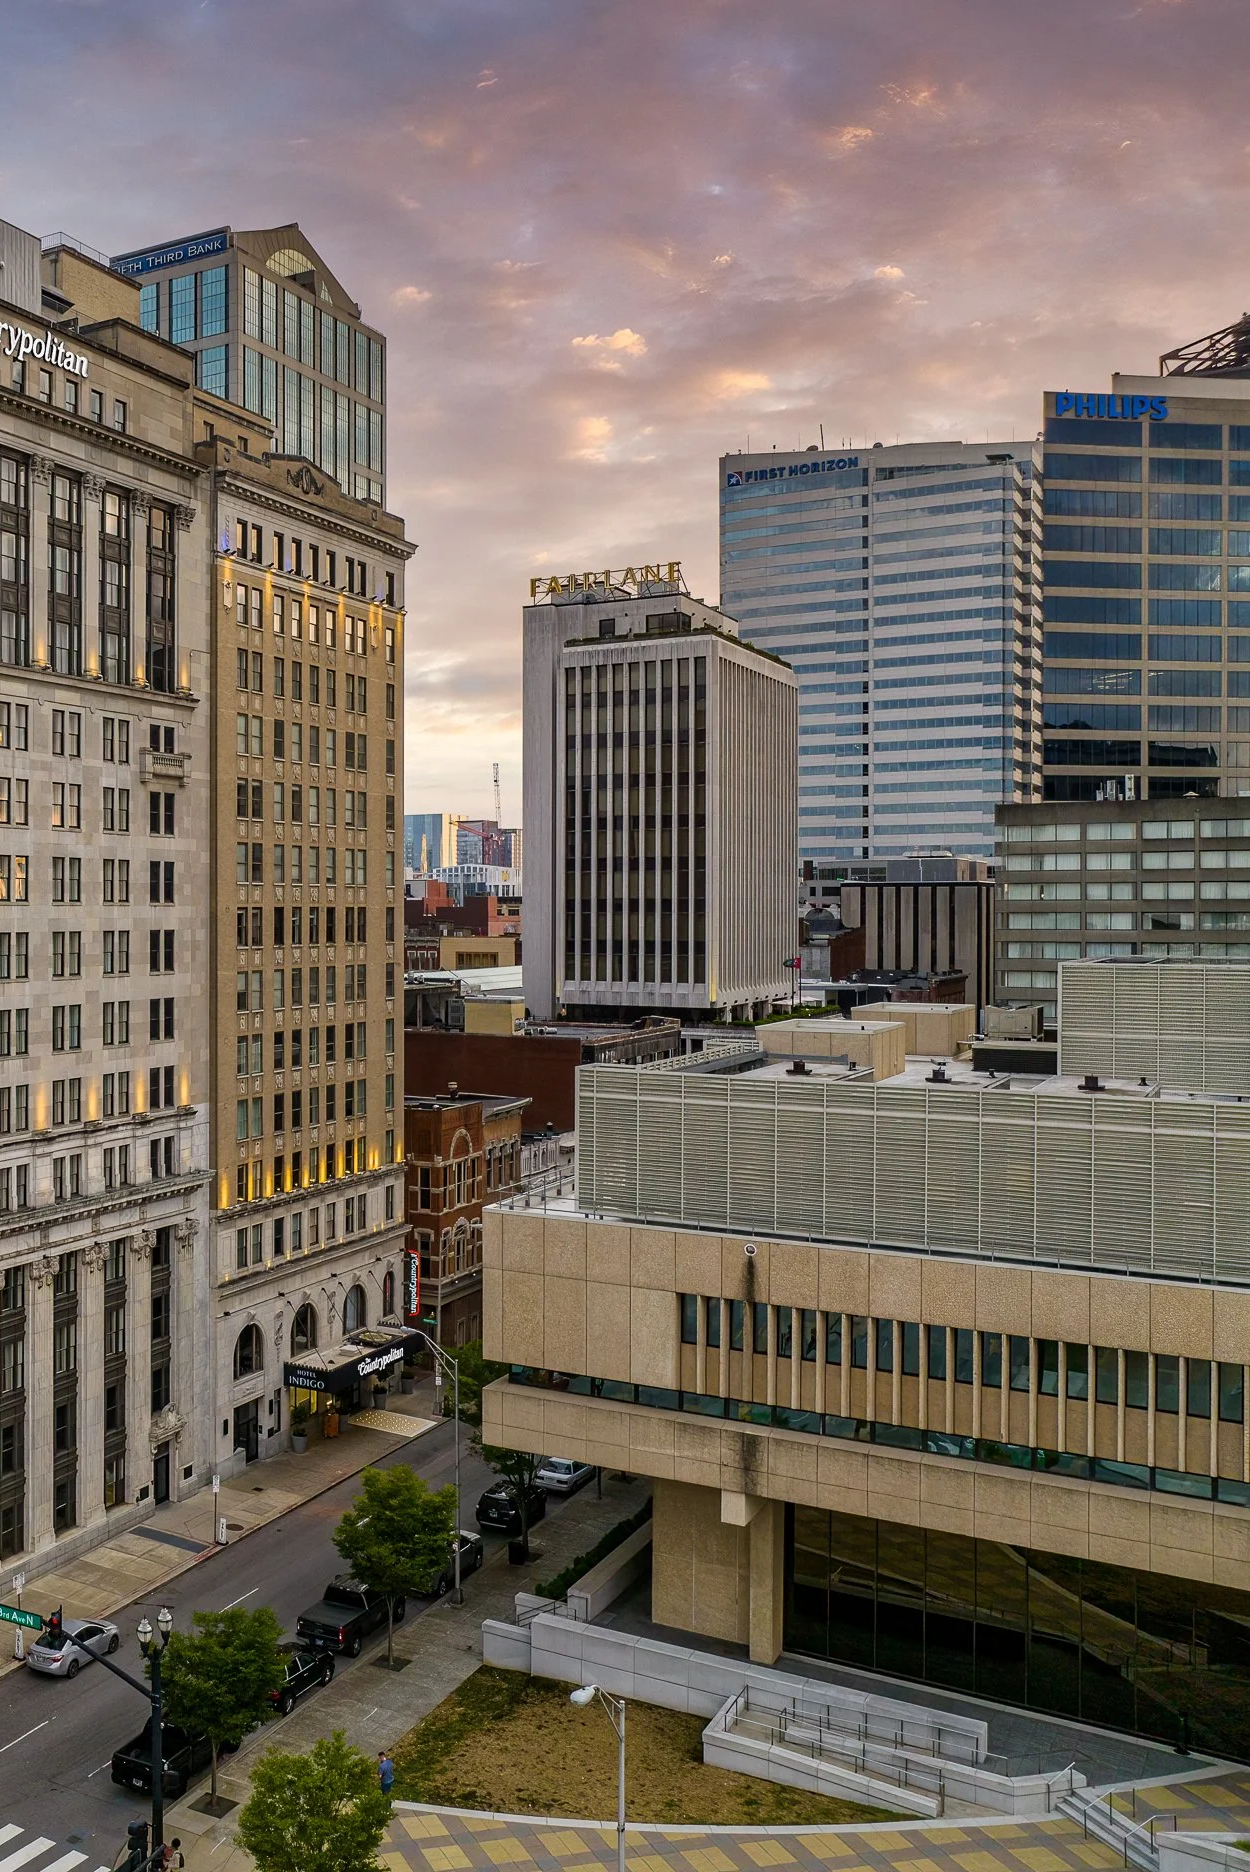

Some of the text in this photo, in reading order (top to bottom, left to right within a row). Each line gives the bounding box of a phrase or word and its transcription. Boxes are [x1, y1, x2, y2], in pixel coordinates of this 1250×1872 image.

[146, 250, 184, 268] THIRD
[188, 240, 222, 257] BANK
[1055, 392, 1169, 421] PHILIPS
[744, 456, 859, 483] FIRST HORIZON
[530, 561, 682, 597] FAIRLANE
[409, 1257, 419, 1314] Countrypolitan
[297, 1369, 317, 1379] HOTEL
[357, 1347, 404, 1376] Countrypolitan
[289, 1375, 325, 1390] INDIGO
[11, 1611, 26, 1624] Ave
[26, 1614, 34, 1626] N
